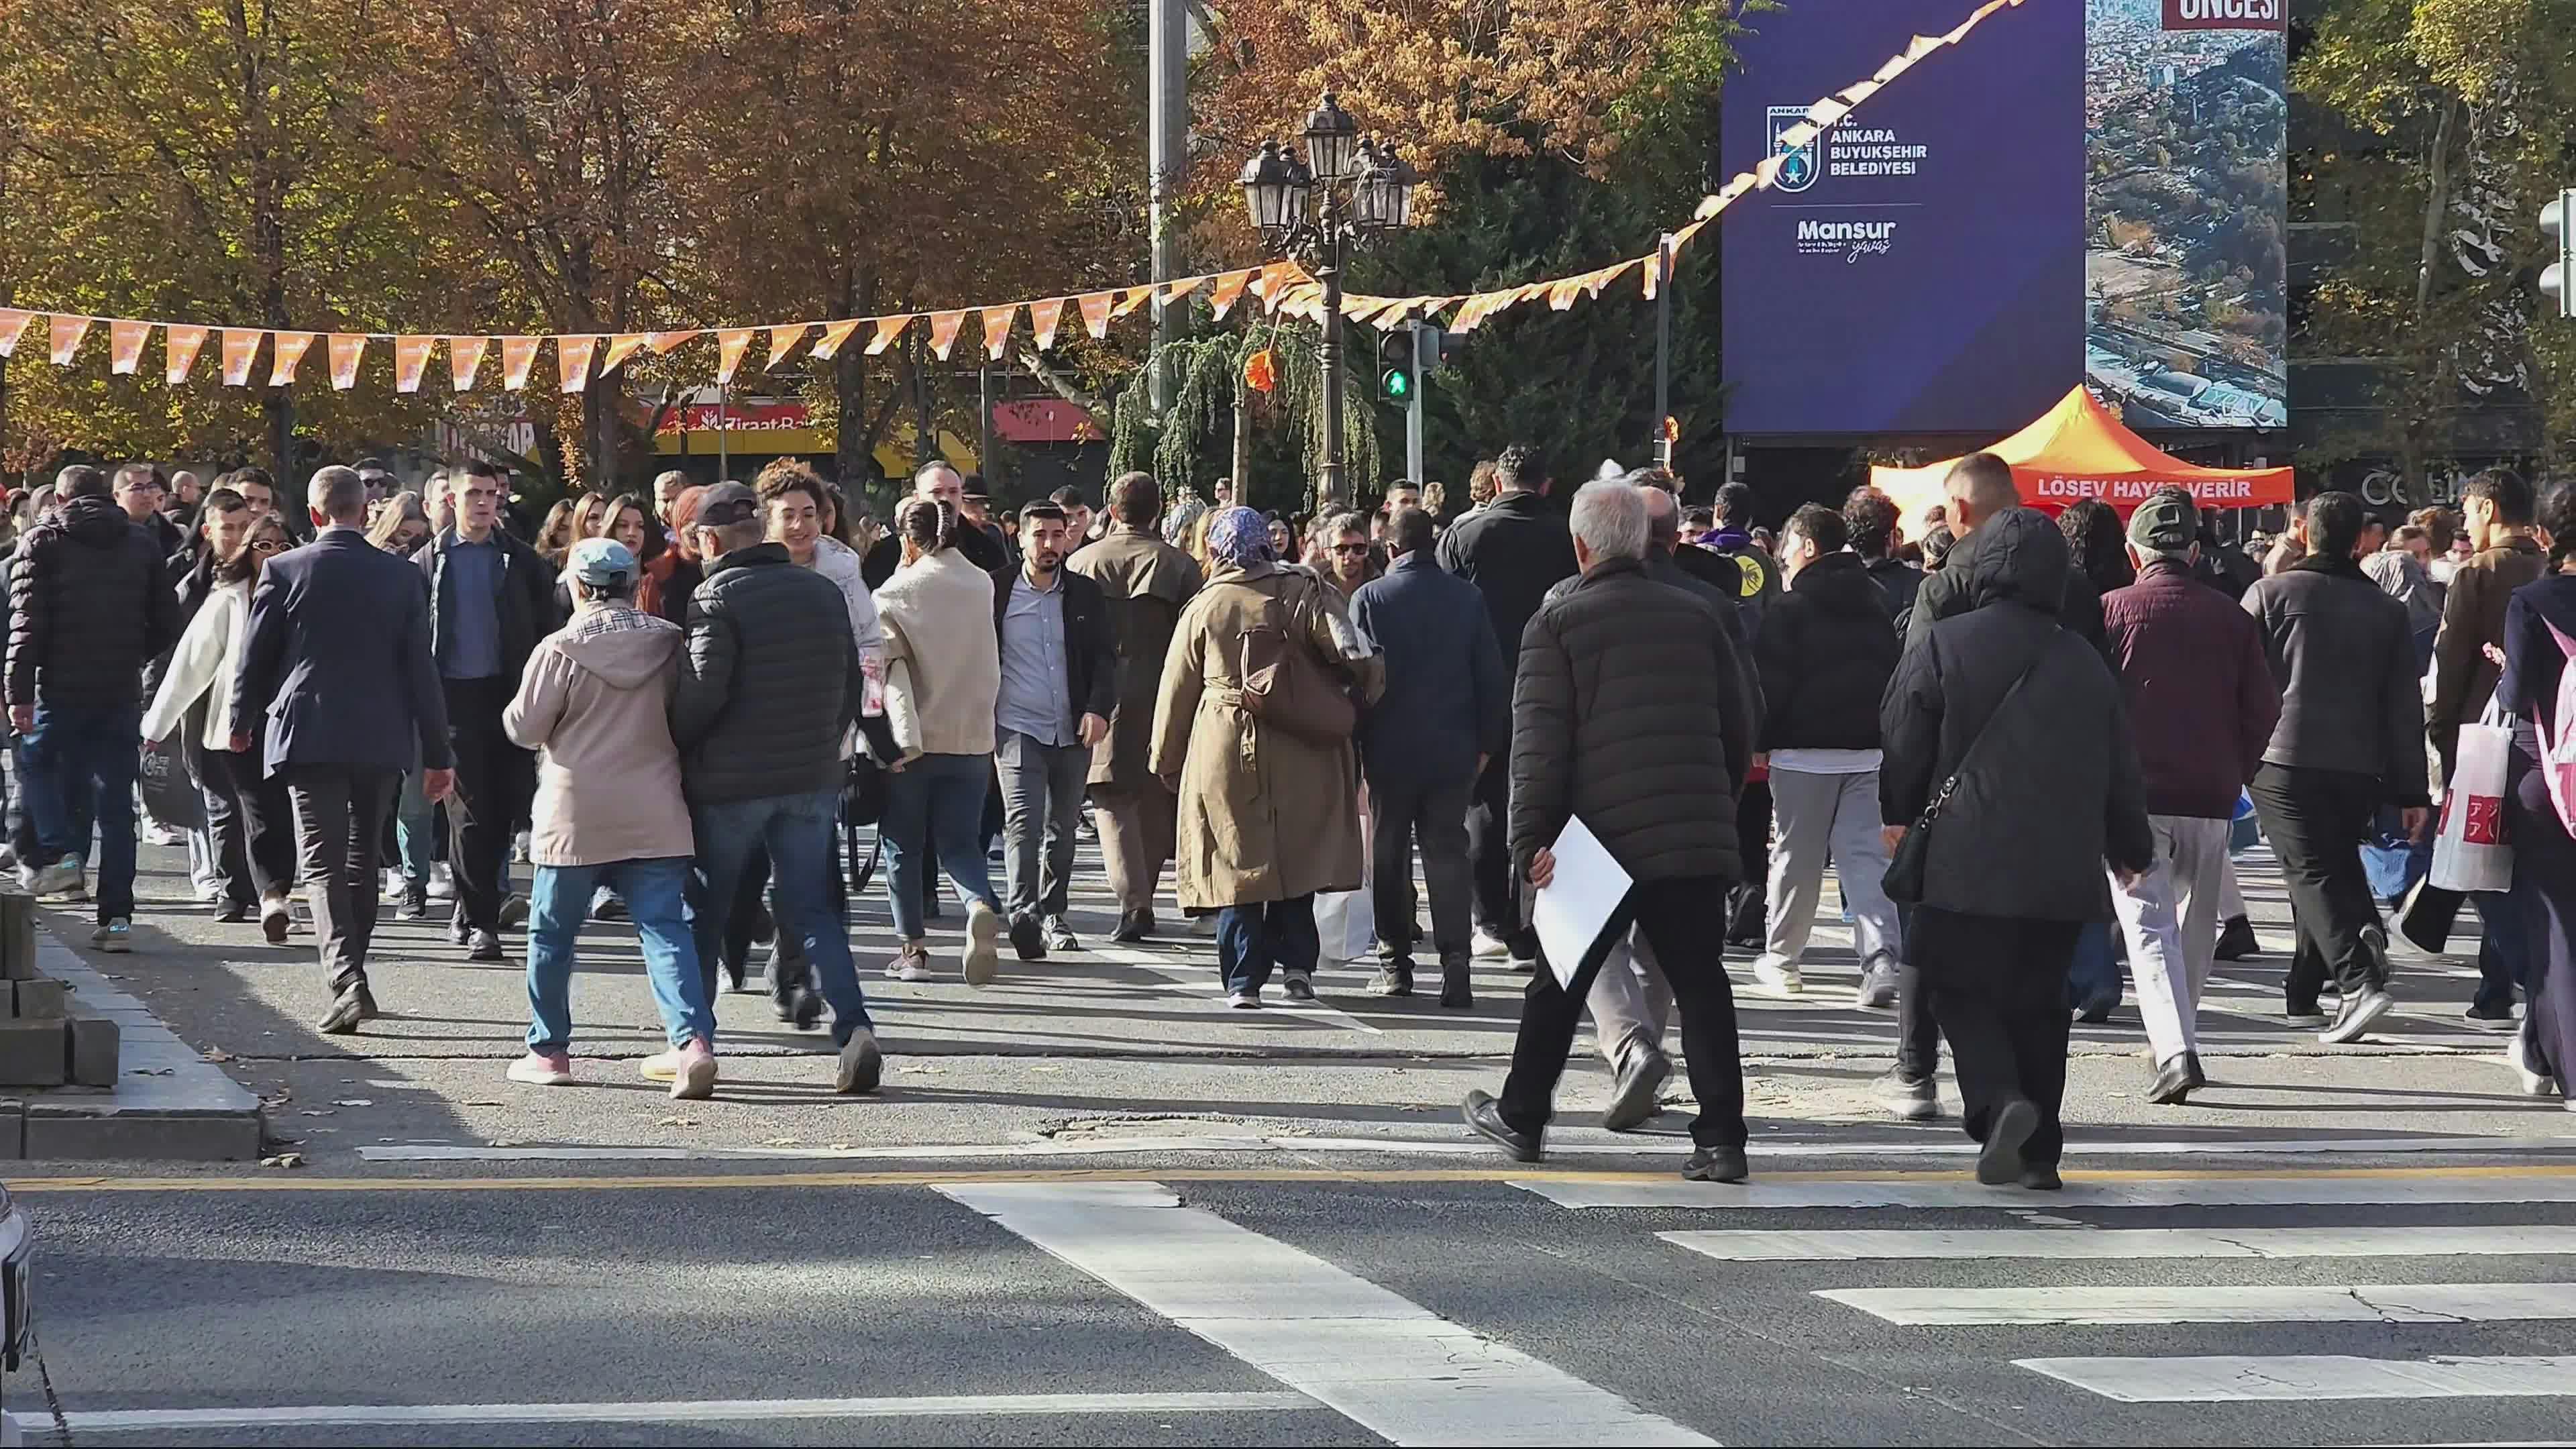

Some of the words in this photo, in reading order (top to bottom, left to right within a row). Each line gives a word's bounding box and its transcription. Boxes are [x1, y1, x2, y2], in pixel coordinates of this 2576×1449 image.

[1830, 129, 1895, 143] ANKARA
[1797, 220, 1896, 240] Mansur
[2038, 475, 2108, 496] LÖSEV
[2114, 481, 2181, 498] HAY
[2188, 478, 2251, 498] VERİR
